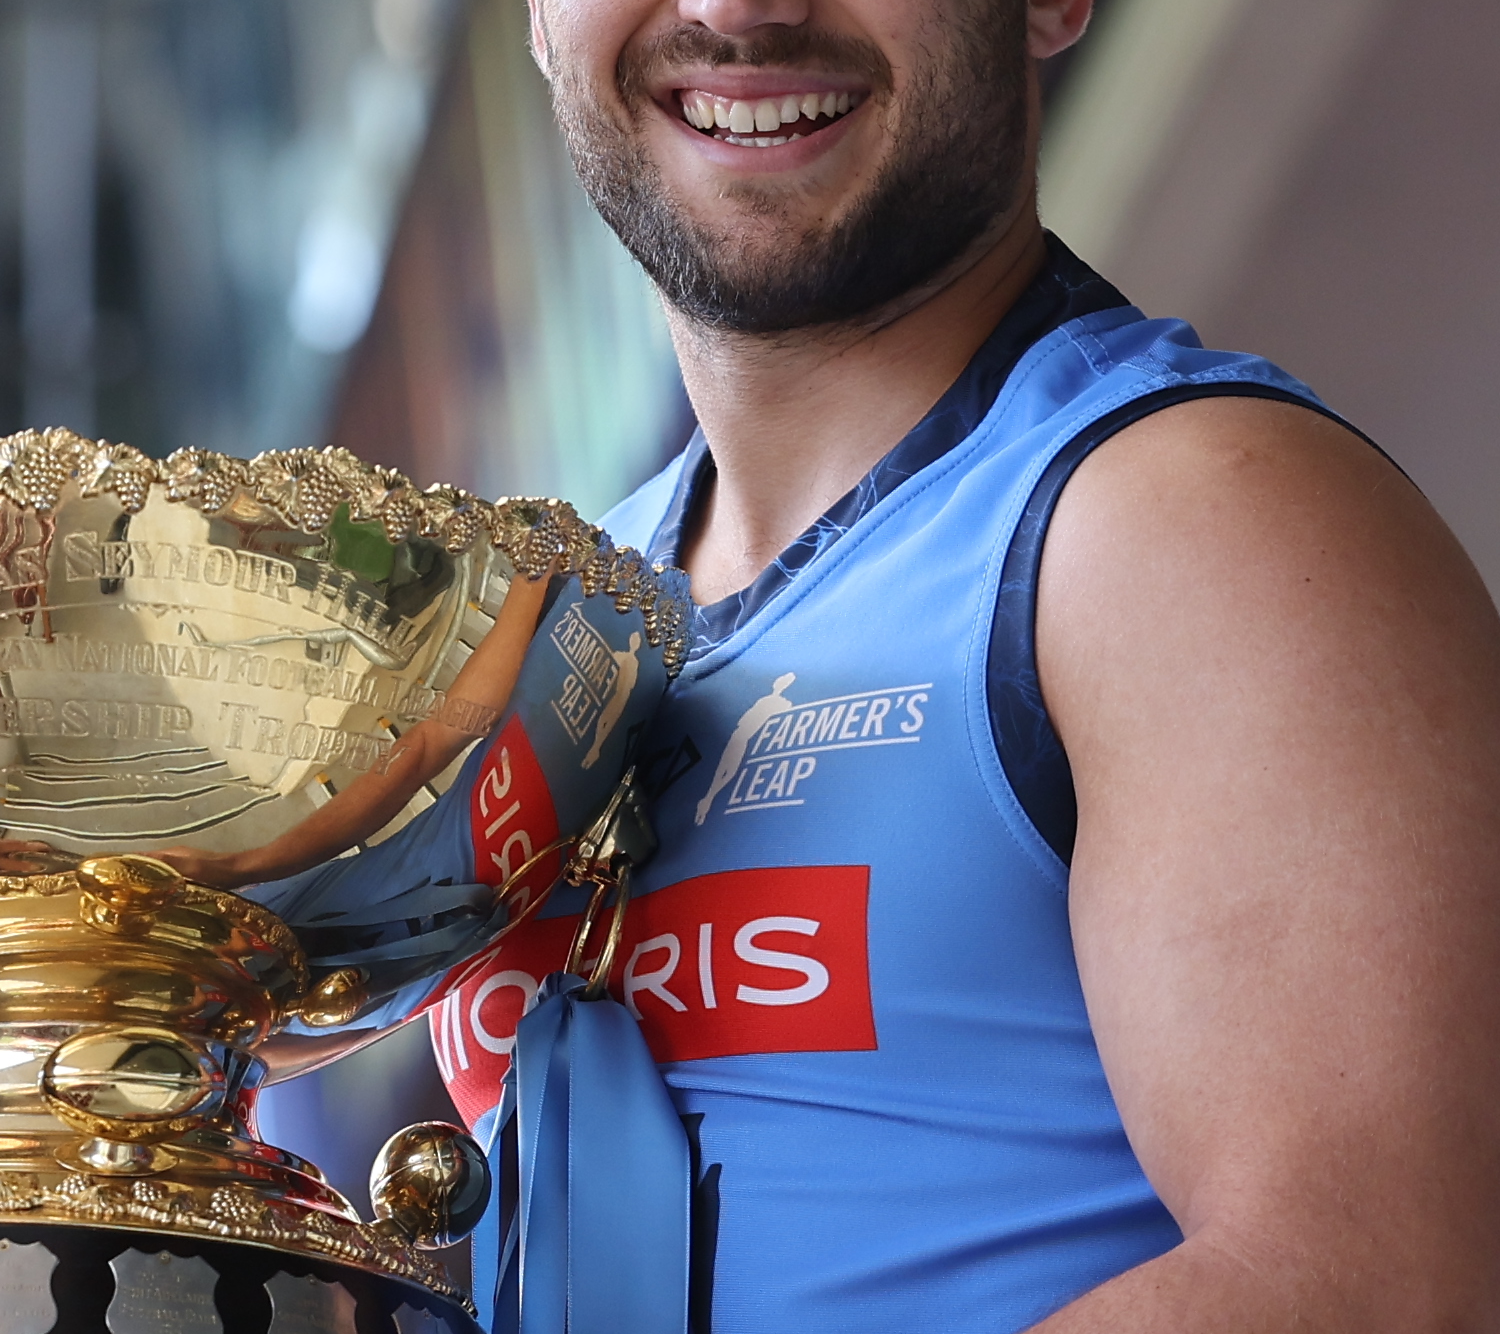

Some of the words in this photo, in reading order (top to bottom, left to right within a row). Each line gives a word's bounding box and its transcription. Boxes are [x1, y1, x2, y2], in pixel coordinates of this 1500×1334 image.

[750, 693, 929, 756] FARMER'S
[728, 756, 817, 806] LEAP
[428, 916, 831, 1084] MORIS
